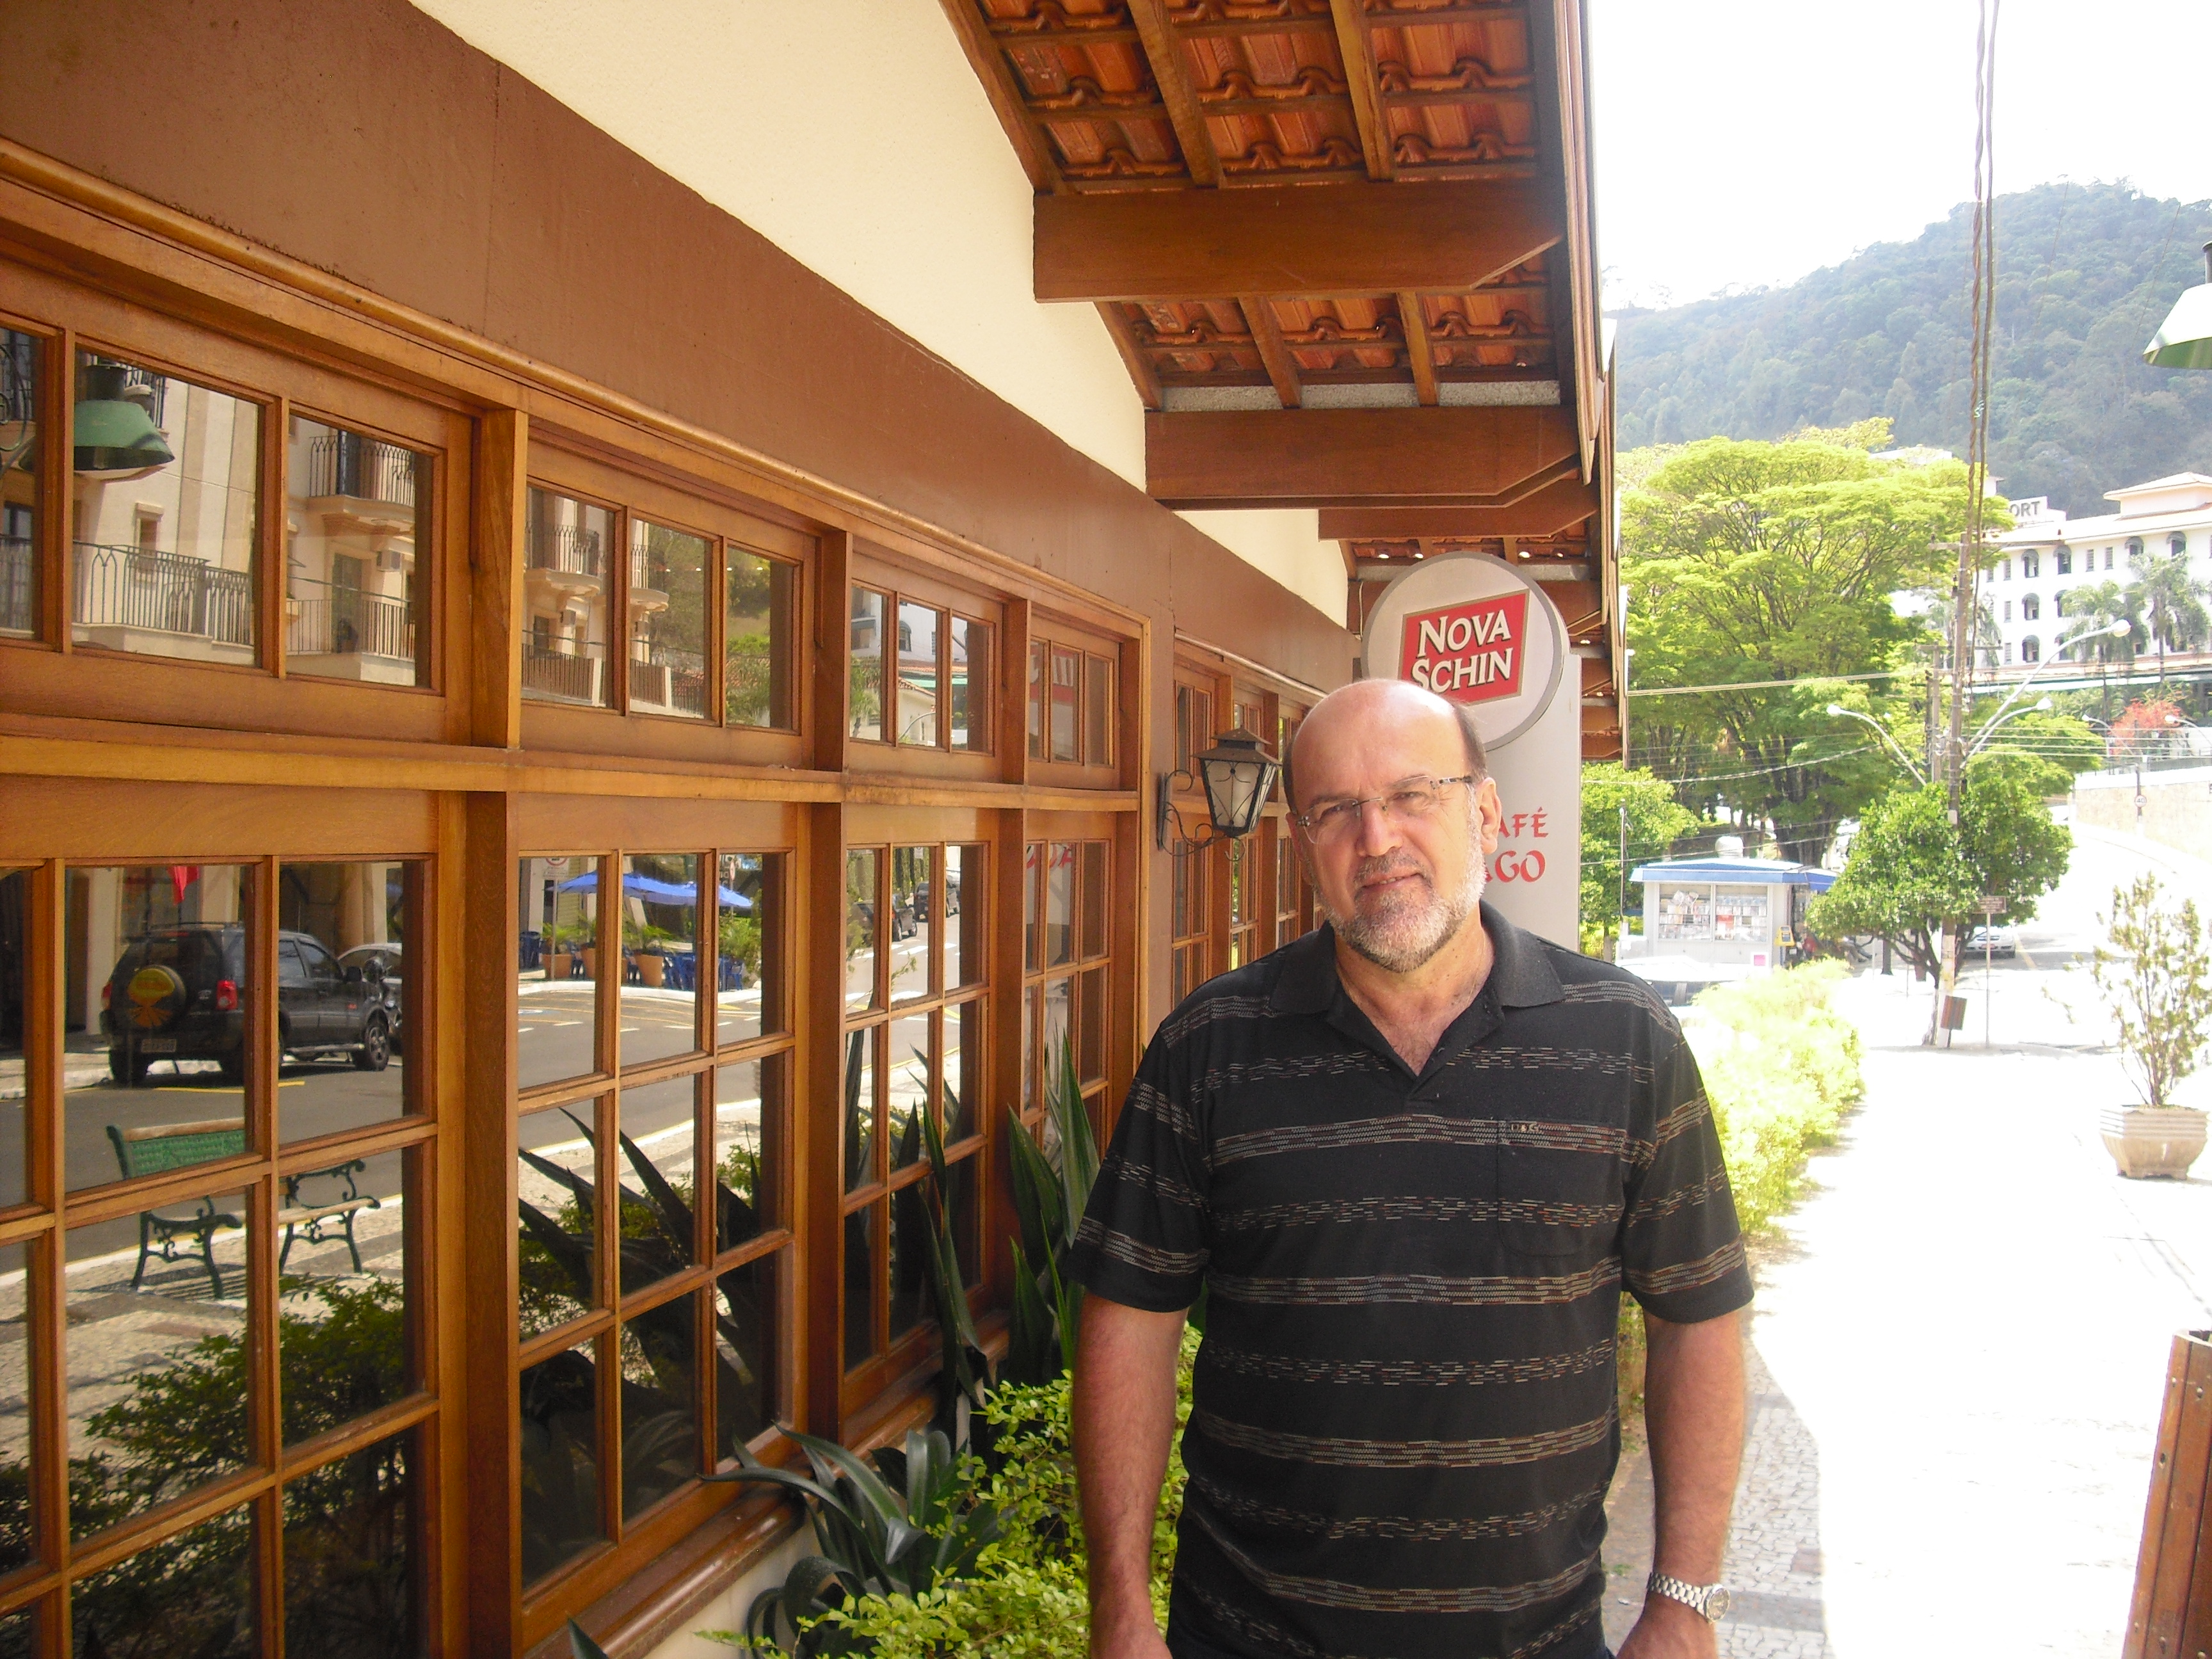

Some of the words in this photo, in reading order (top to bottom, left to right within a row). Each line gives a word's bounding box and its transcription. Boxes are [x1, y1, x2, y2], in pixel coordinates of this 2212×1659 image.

[1416, 609, 1512, 659] NOVA
[1412, 647, 1514, 693] SCHIN
[1485, 849, 1546, 883] GO
